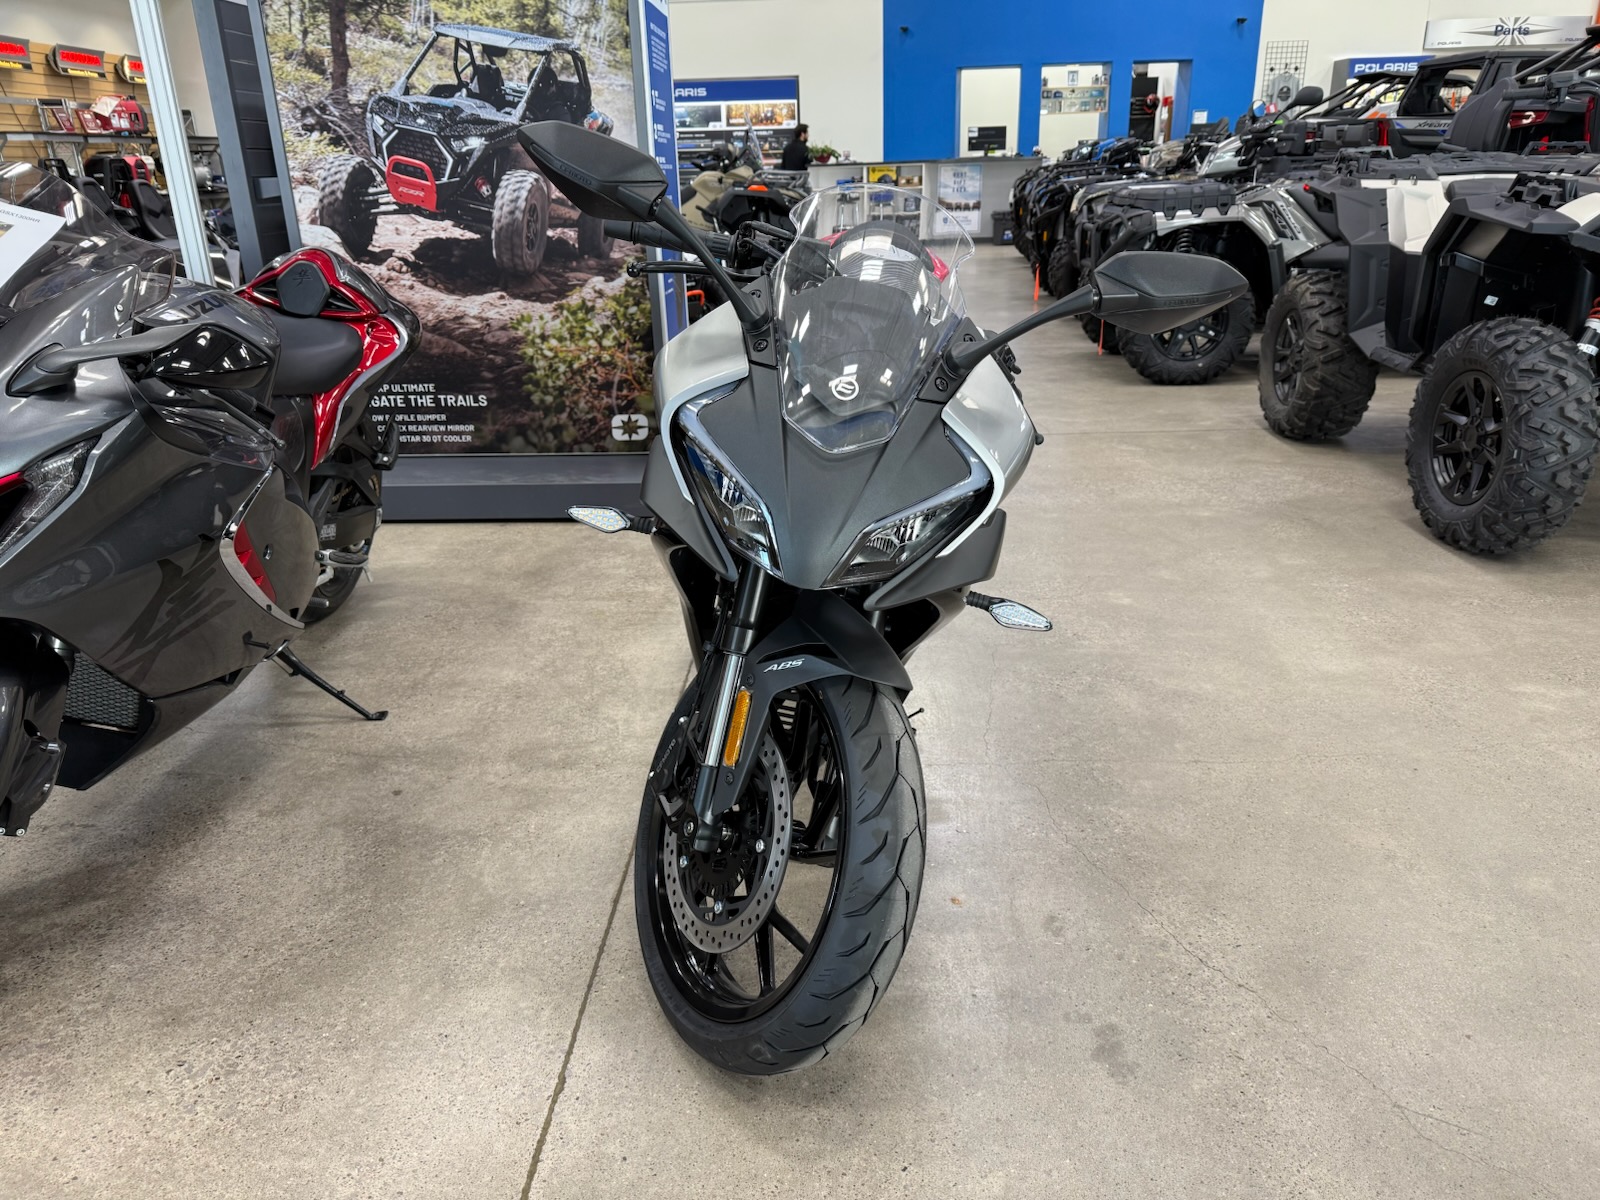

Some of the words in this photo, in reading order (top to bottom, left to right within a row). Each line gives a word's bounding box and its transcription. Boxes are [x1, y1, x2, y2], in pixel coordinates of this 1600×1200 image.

[1494, 24, 1531, 36] Parts
[1354, 62, 1418, 73] POLARIS
[674, 87, 707, 97] ARIS
[391, 383, 436, 393] ULTIMATE
[369, 394, 406, 407] GATE
[408, 394, 436, 407] THE
[438, 394, 488, 407] TRAILS
[372, 414, 384, 422] OW
[385, 414, 416, 422] POFILE
[417, 414, 447, 422] BUMPER
[408, 424, 446, 432] REARVIEW
[447, 424, 475, 432] MIRROR
[422, 435, 432, 443] 30
[432, 435, 442, 443] QT
[443, 434, 472, 442] COOLER
[763, 658, 805, 673] ABS
